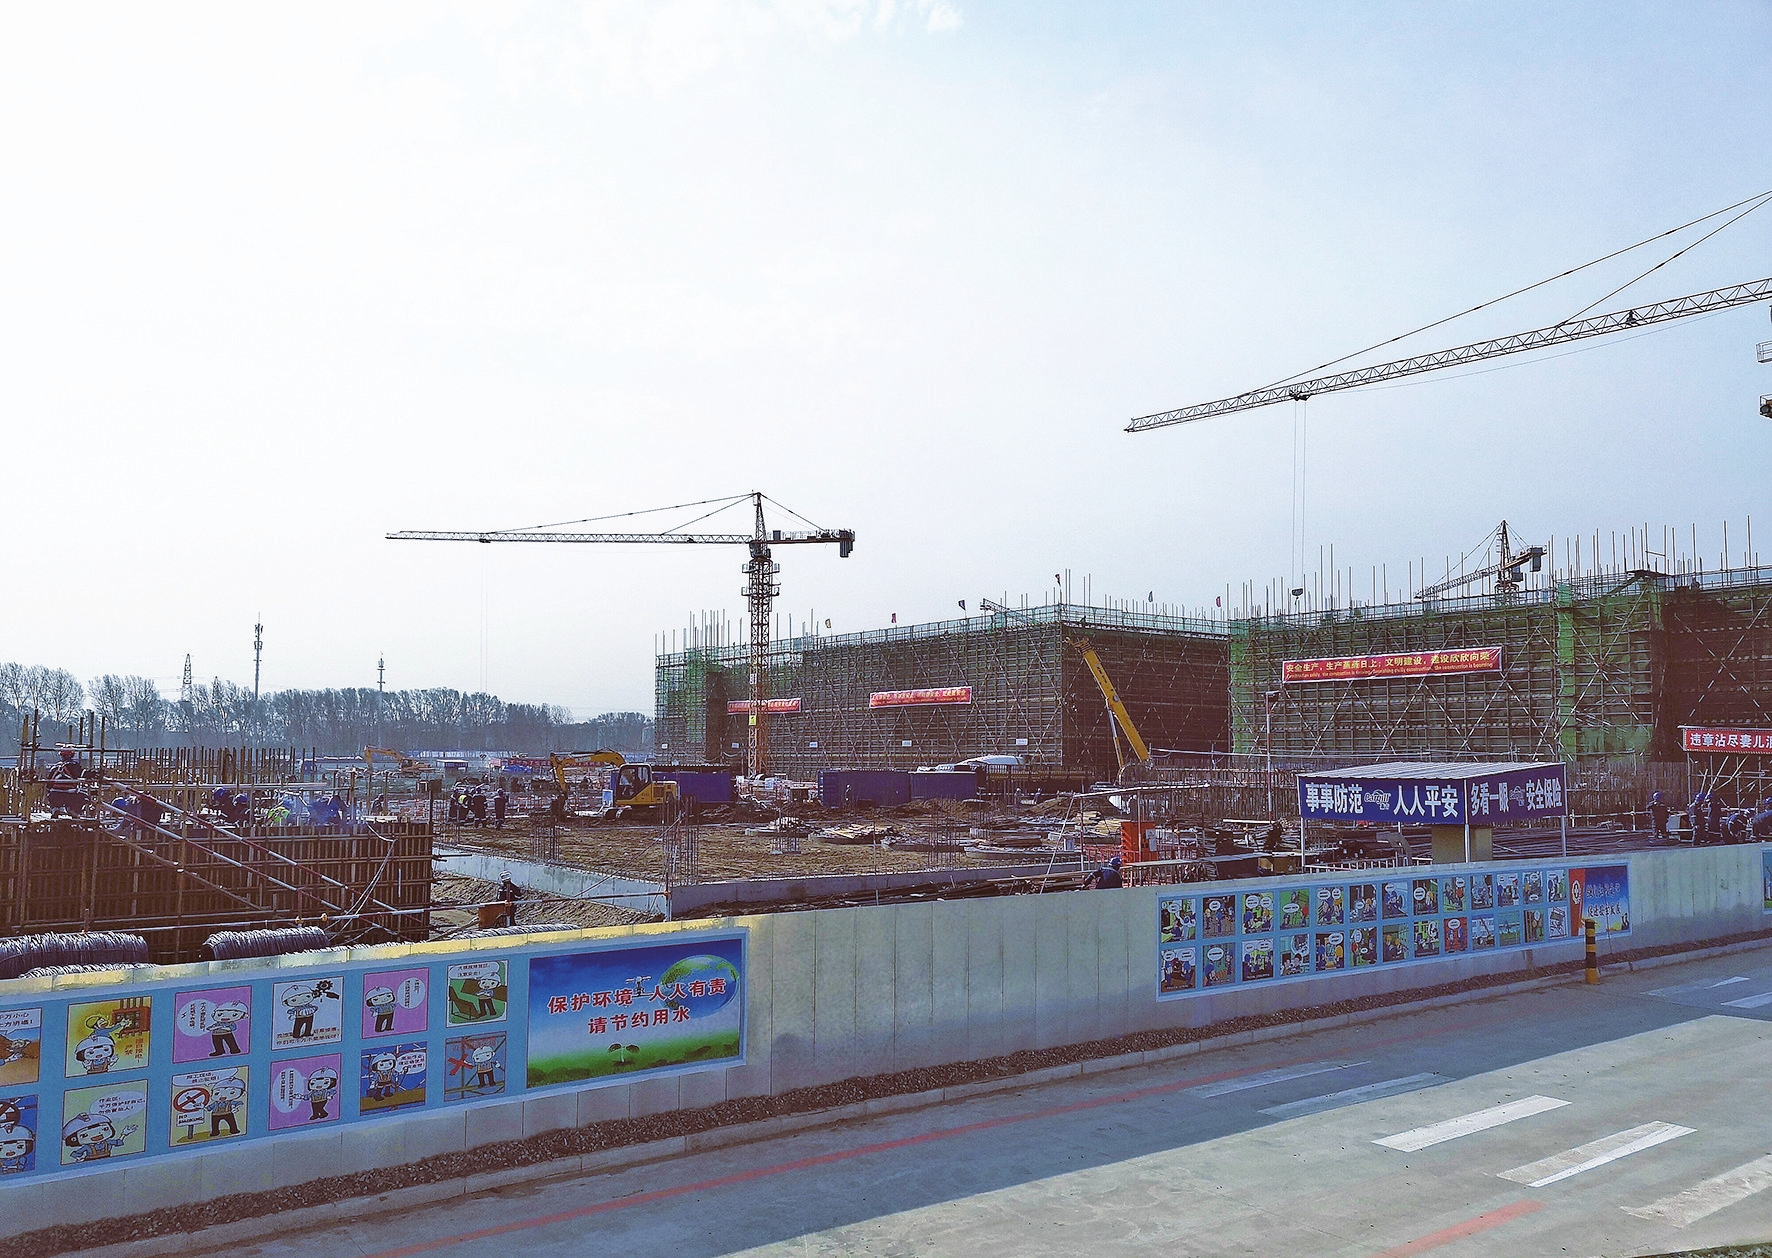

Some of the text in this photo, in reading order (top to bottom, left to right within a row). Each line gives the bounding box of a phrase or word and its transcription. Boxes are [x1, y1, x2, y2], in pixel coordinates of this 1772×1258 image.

[1305, 782, 1364, 814] 事事防范
[1393, 784, 1459, 818] 人人平安
[1471, 782, 1509, 816] 多看一眼
[1526, 777, 1562, 811] 安全保险
[547, 977, 727, 1014] 保护环境 人人有责
[587, 1006, 691, 1035] 请节约用水
